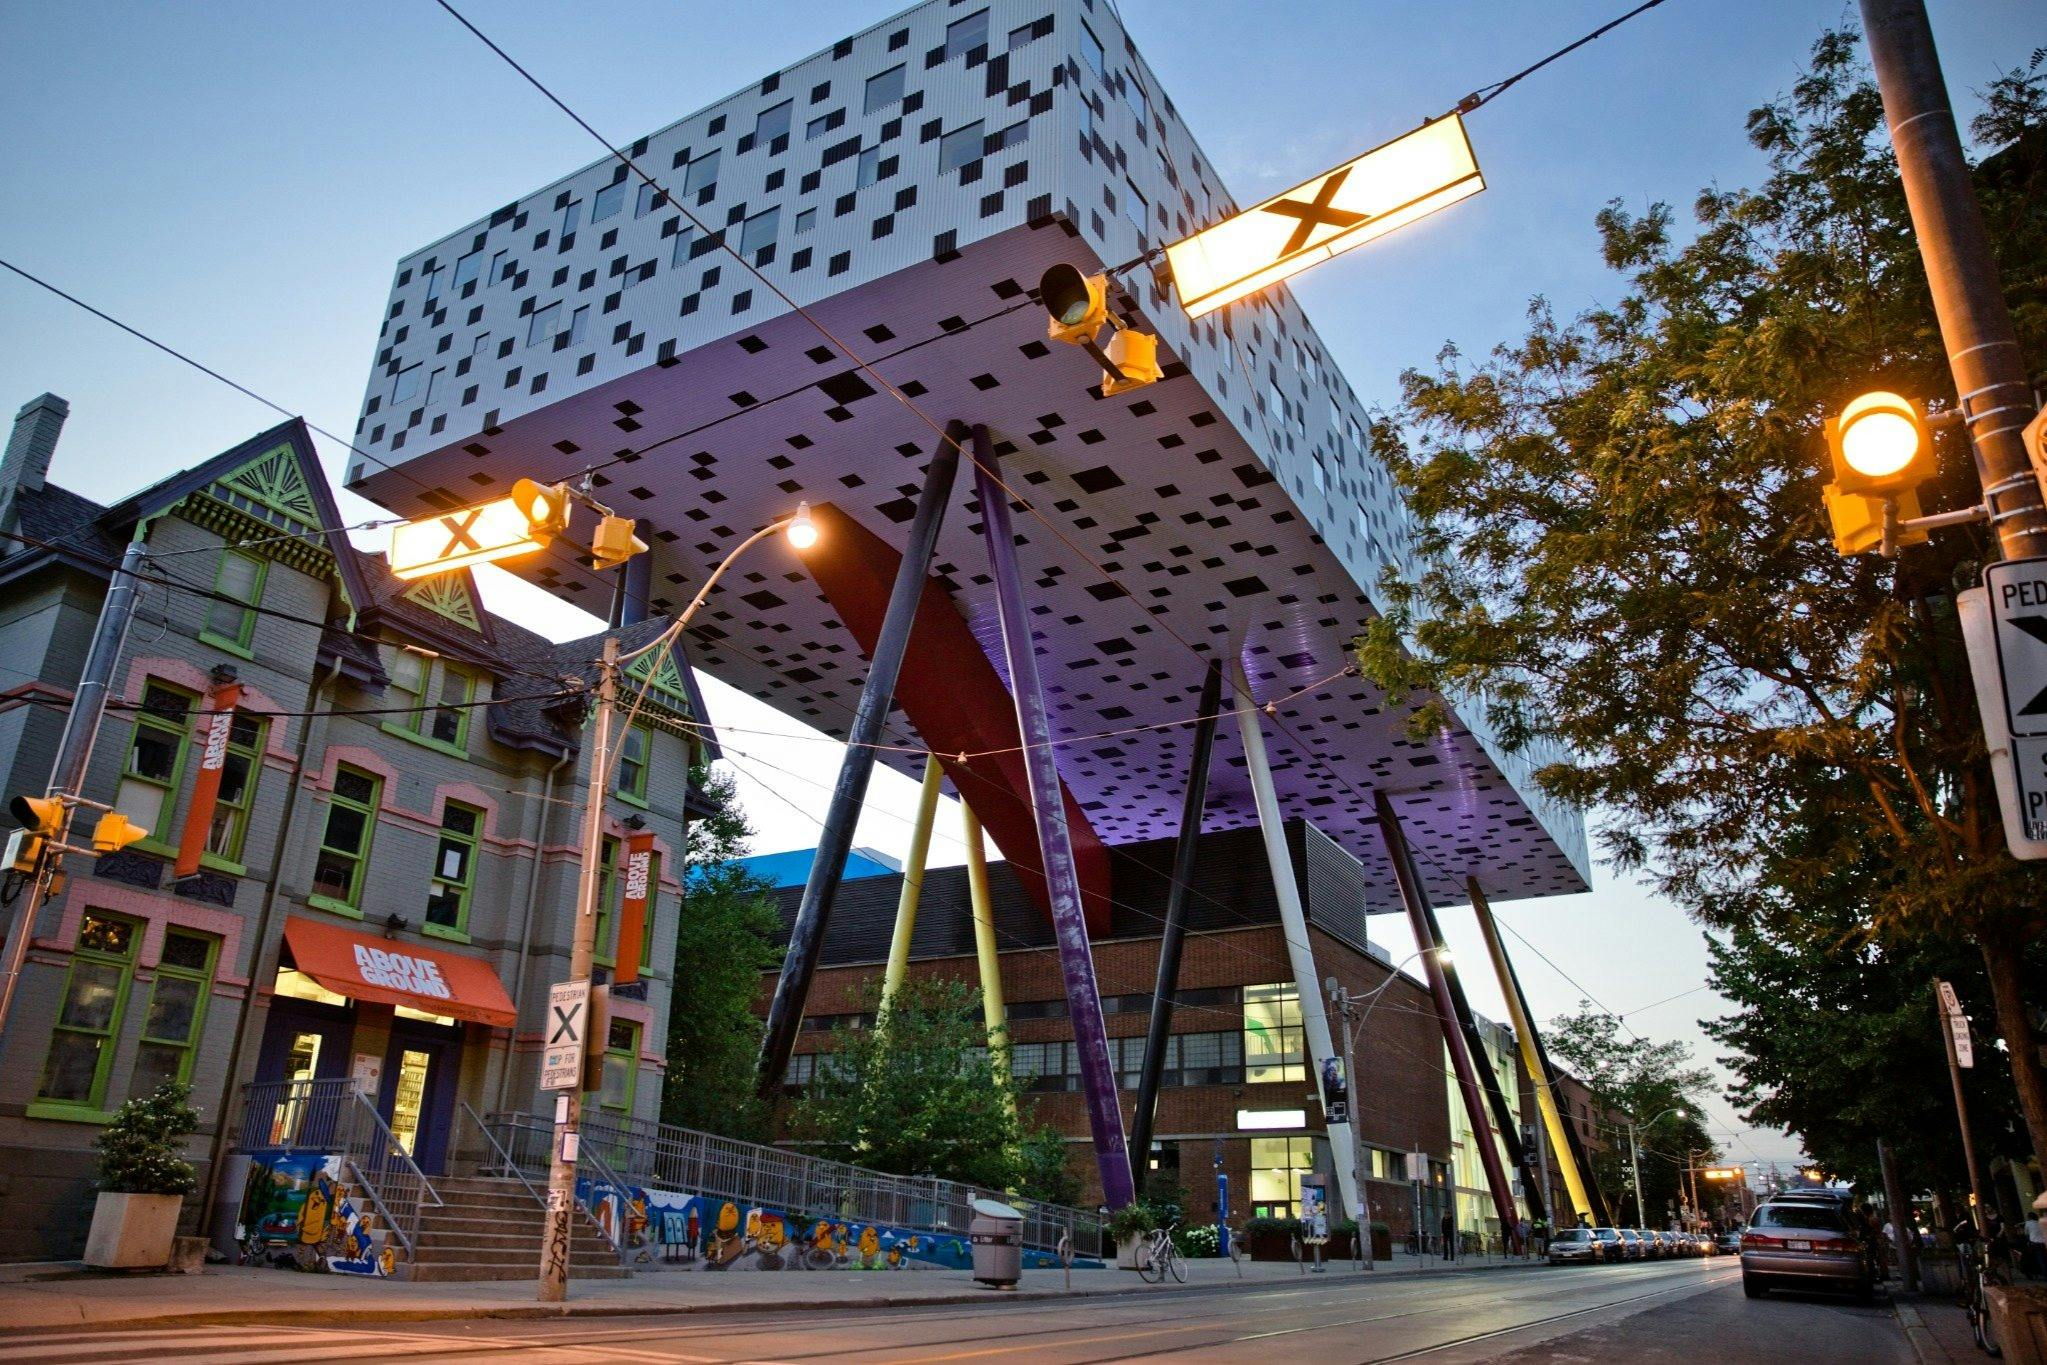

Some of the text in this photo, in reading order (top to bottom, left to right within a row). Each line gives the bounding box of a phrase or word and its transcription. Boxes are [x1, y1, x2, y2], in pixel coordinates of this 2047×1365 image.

[626, 853, 641, 900] ABOVE
[353, 944, 440, 980] ABOVE
[360, 966, 450, 999] GROUND
[552, 989, 585, 1002] PEDESTRIAN
